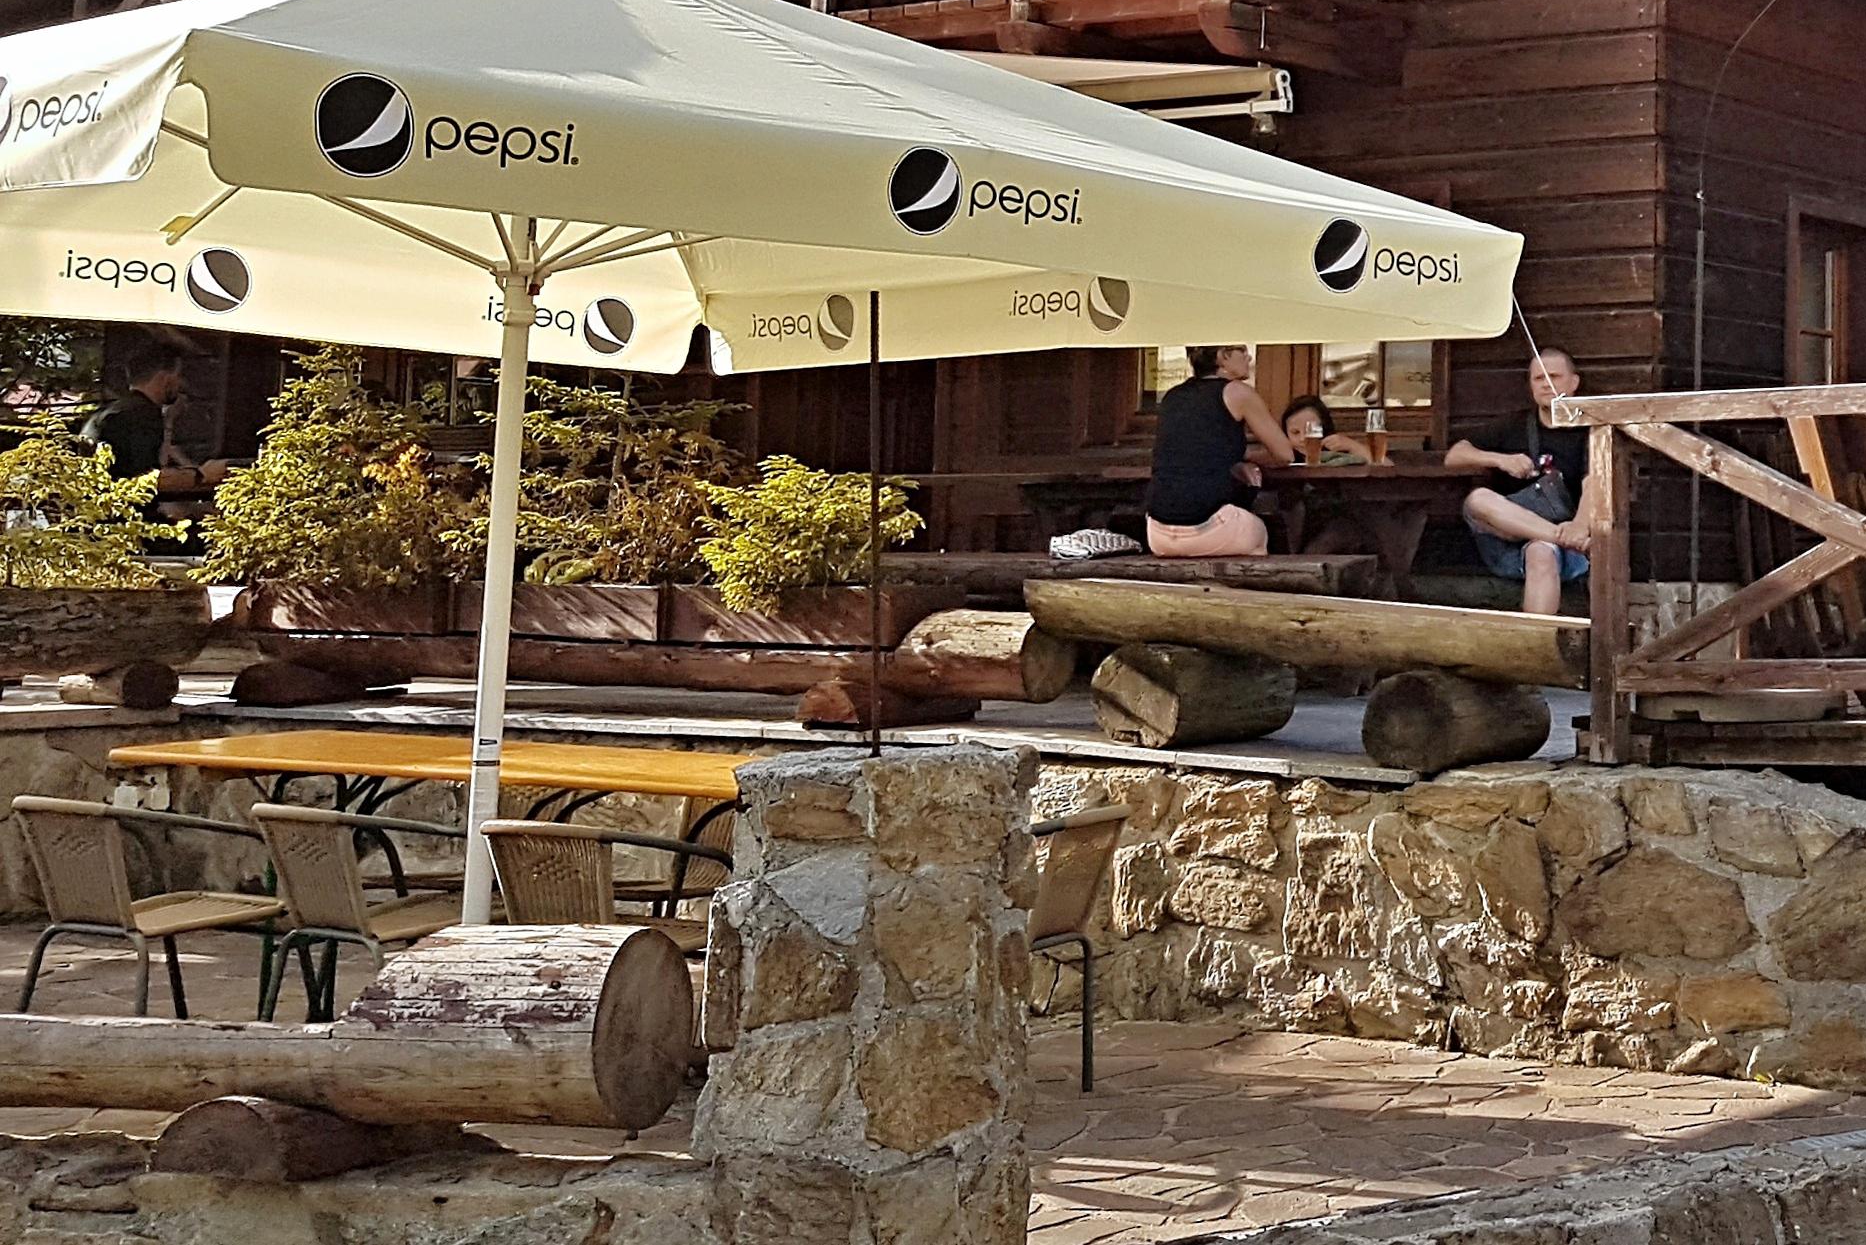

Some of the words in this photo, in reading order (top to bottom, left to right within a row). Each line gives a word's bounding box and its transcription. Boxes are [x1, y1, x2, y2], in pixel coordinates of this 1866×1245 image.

[425, 116, 579, 168] pepsi
[968, 180, 1083, 225] pepsi
[1374, 248, 1462, 285] pepsi
